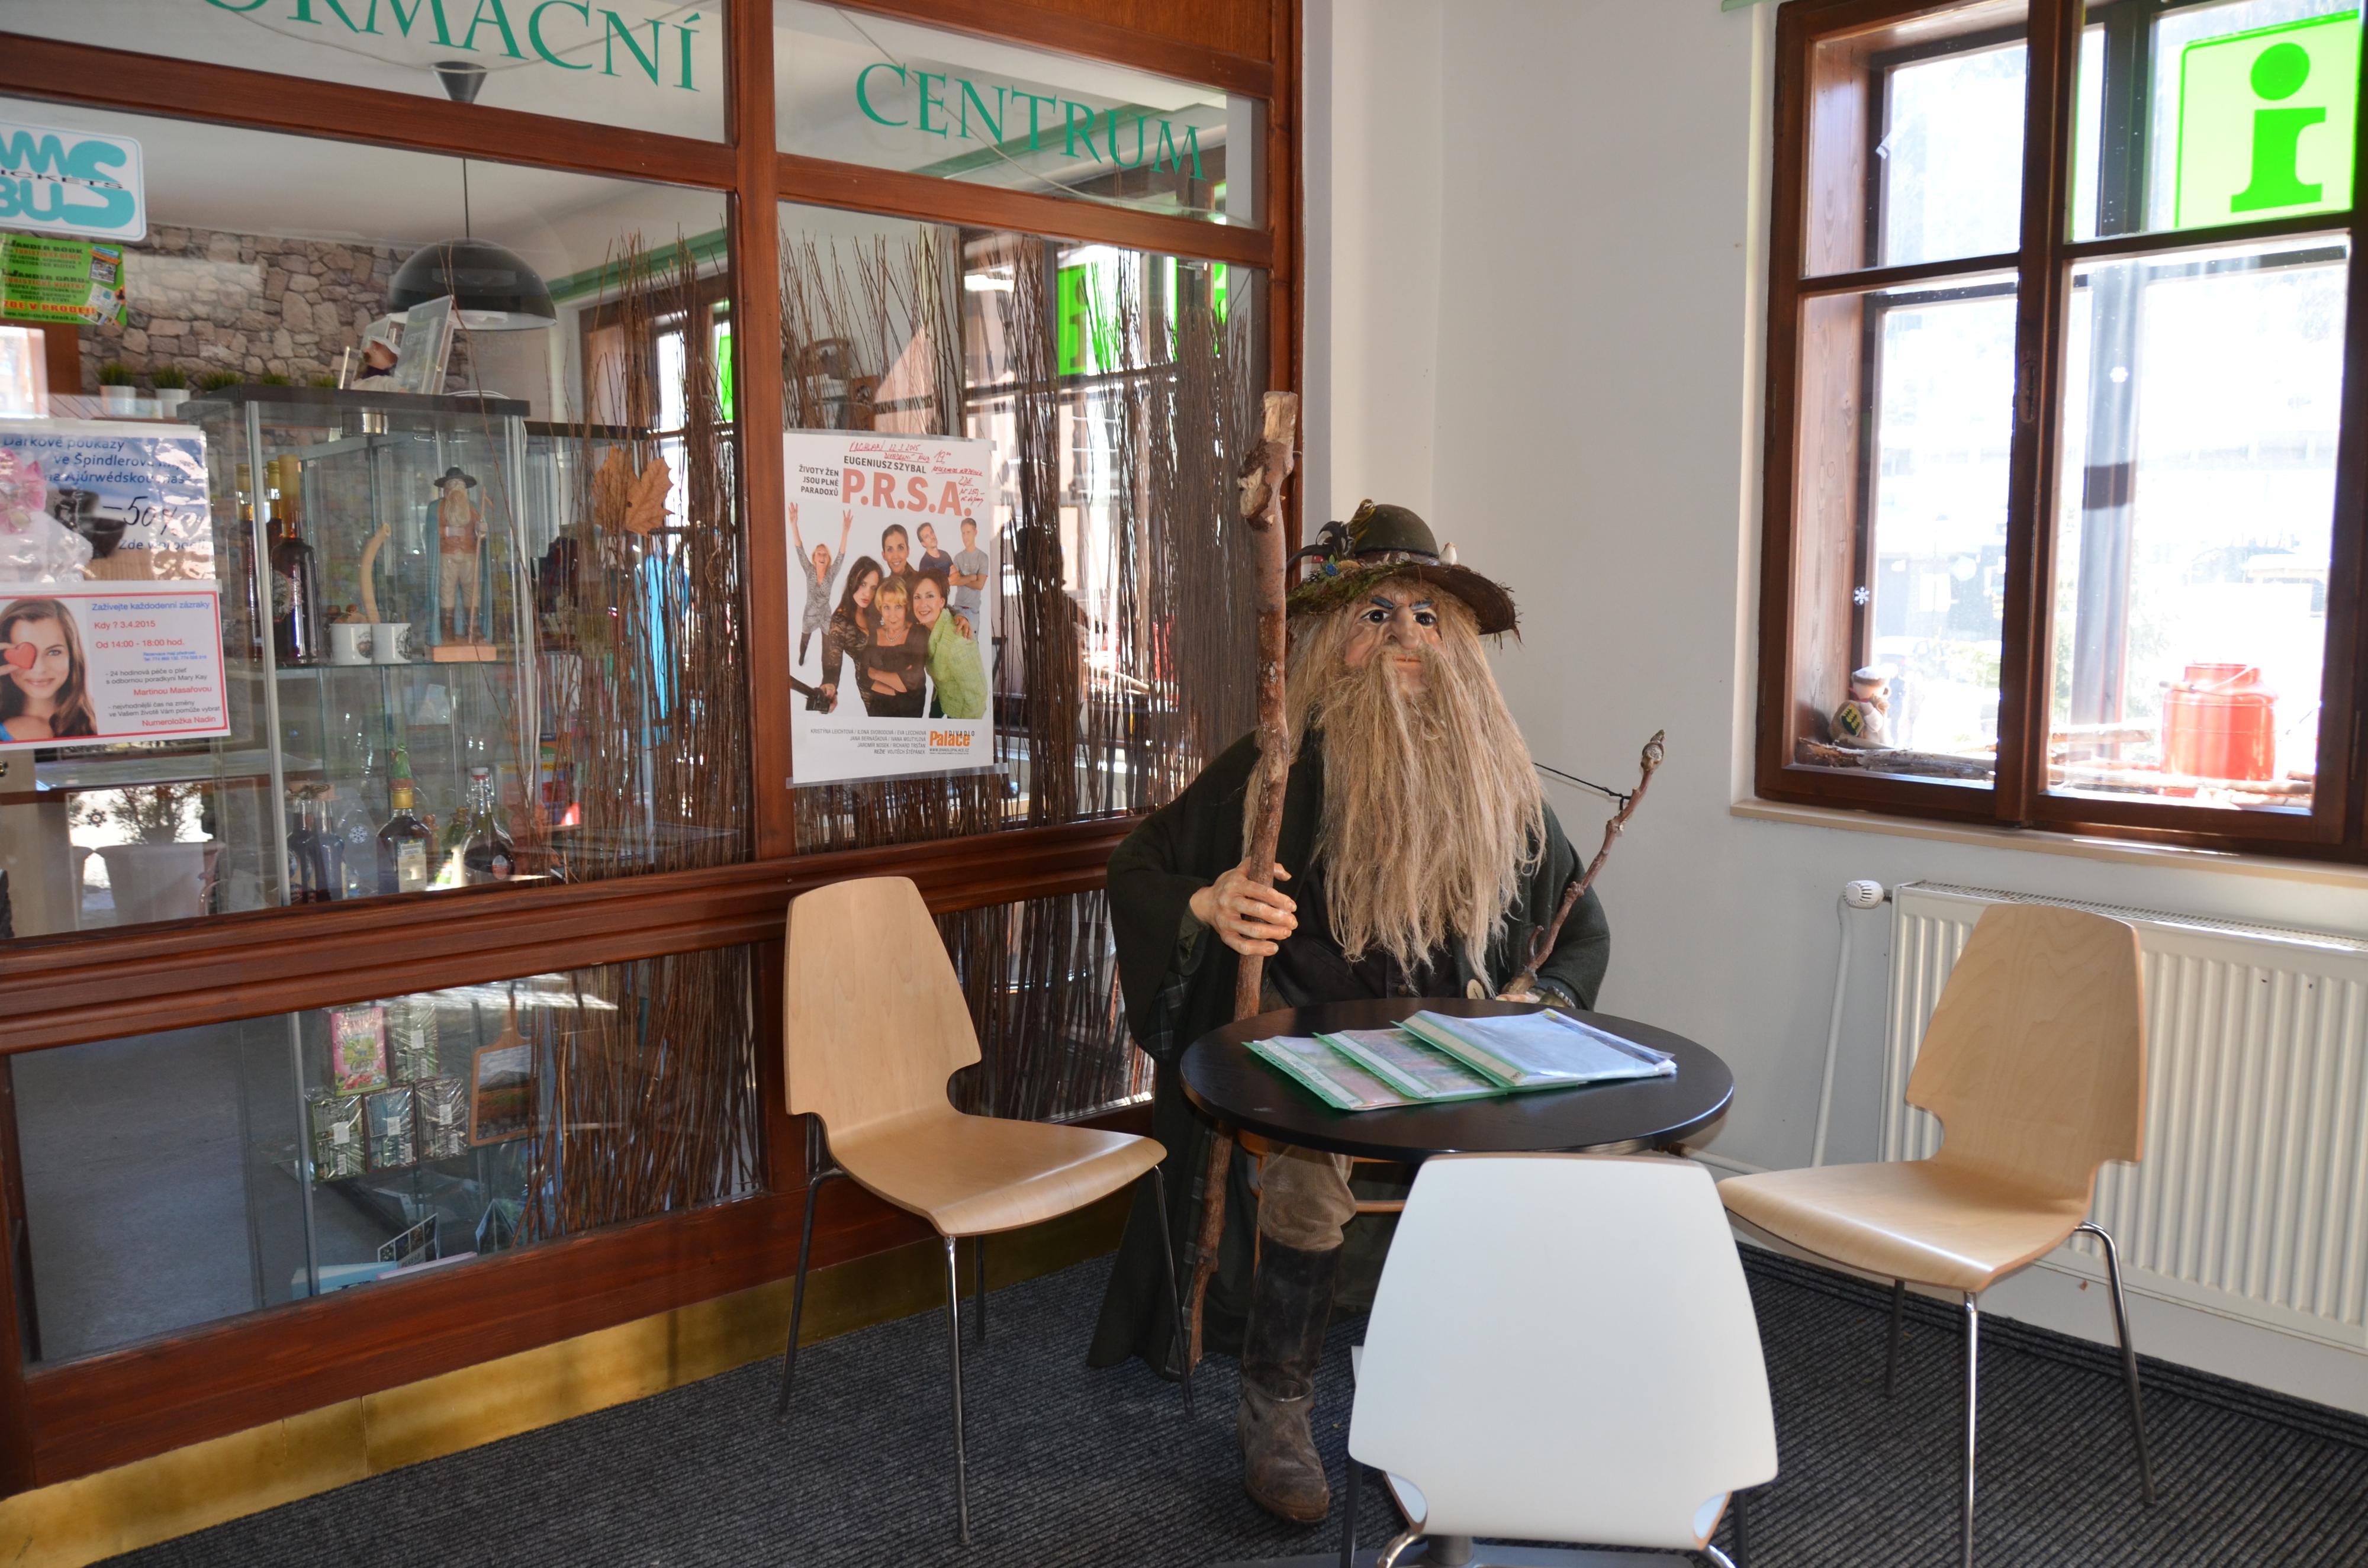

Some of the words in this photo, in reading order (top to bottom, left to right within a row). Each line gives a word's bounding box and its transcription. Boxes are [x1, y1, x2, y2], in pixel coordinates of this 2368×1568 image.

[856, 62, 1206, 181] CENTRUM
[54, 455, 70, 464] ve
[844, 455, 892, 469] EUGENIUSZ
[894, 462, 926, 474] SZYBAL
[799, 464, 824, 475] ŽIVOTY
[825, 466, 839, 476] ŽEN
[803, 476, 821, 485] JSOU
[821, 476, 839, 487] PLNÉ
[800, 485, 838, 496] PARADOXŮ
[842, 468, 971, 517] P.R.S.A.
[118, 539, 144, 550] Zde
[179, 601, 210, 609] zázraky
[94, 622, 111, 630] Kdy
[120, 620, 156, 629] 3.4.2015
[142, 639, 165, 647] 18:00
[133, 688, 168, 696] Martinou
[141, 717, 192, 726] Numeroložka
[929, 730, 970, 746] Palace
